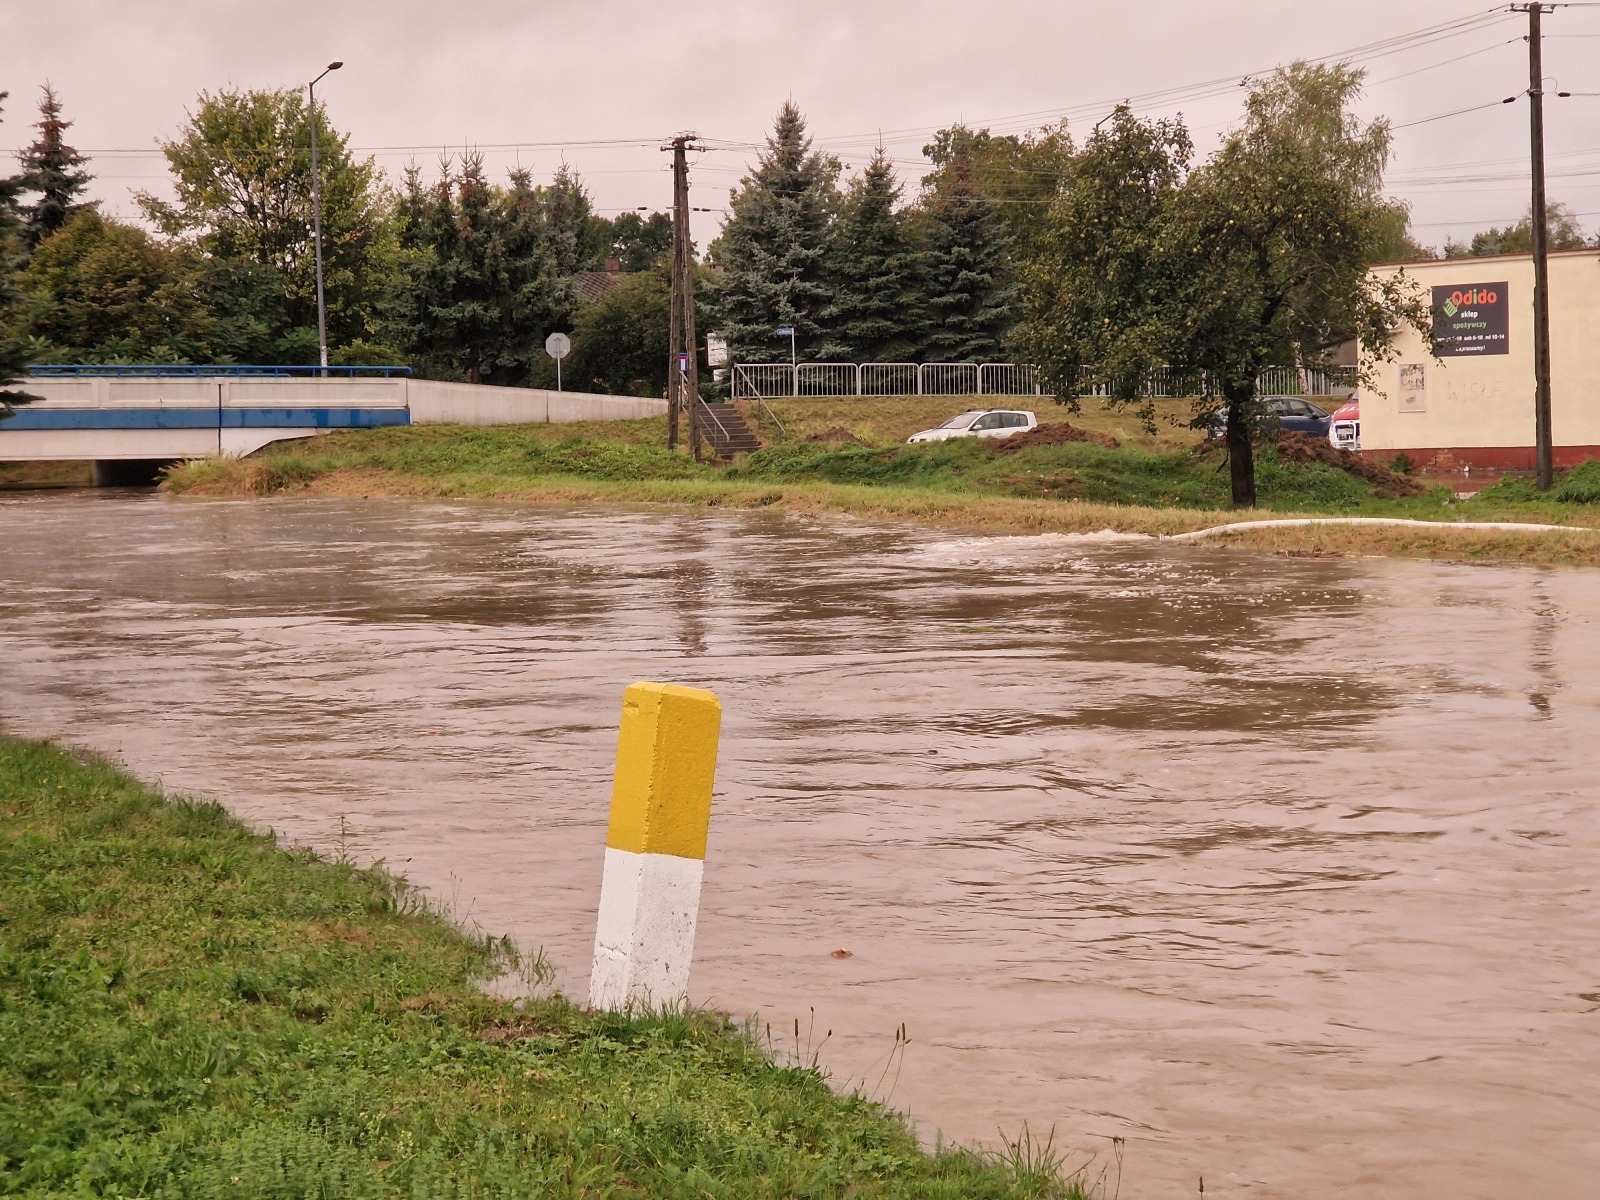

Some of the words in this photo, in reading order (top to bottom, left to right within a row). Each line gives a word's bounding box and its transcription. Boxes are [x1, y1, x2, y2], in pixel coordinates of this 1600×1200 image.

[1451, 288, 1498, 305] Odido
[1460, 310, 1478, 318] sklep
[1452, 321, 1487, 330] spożywczy
